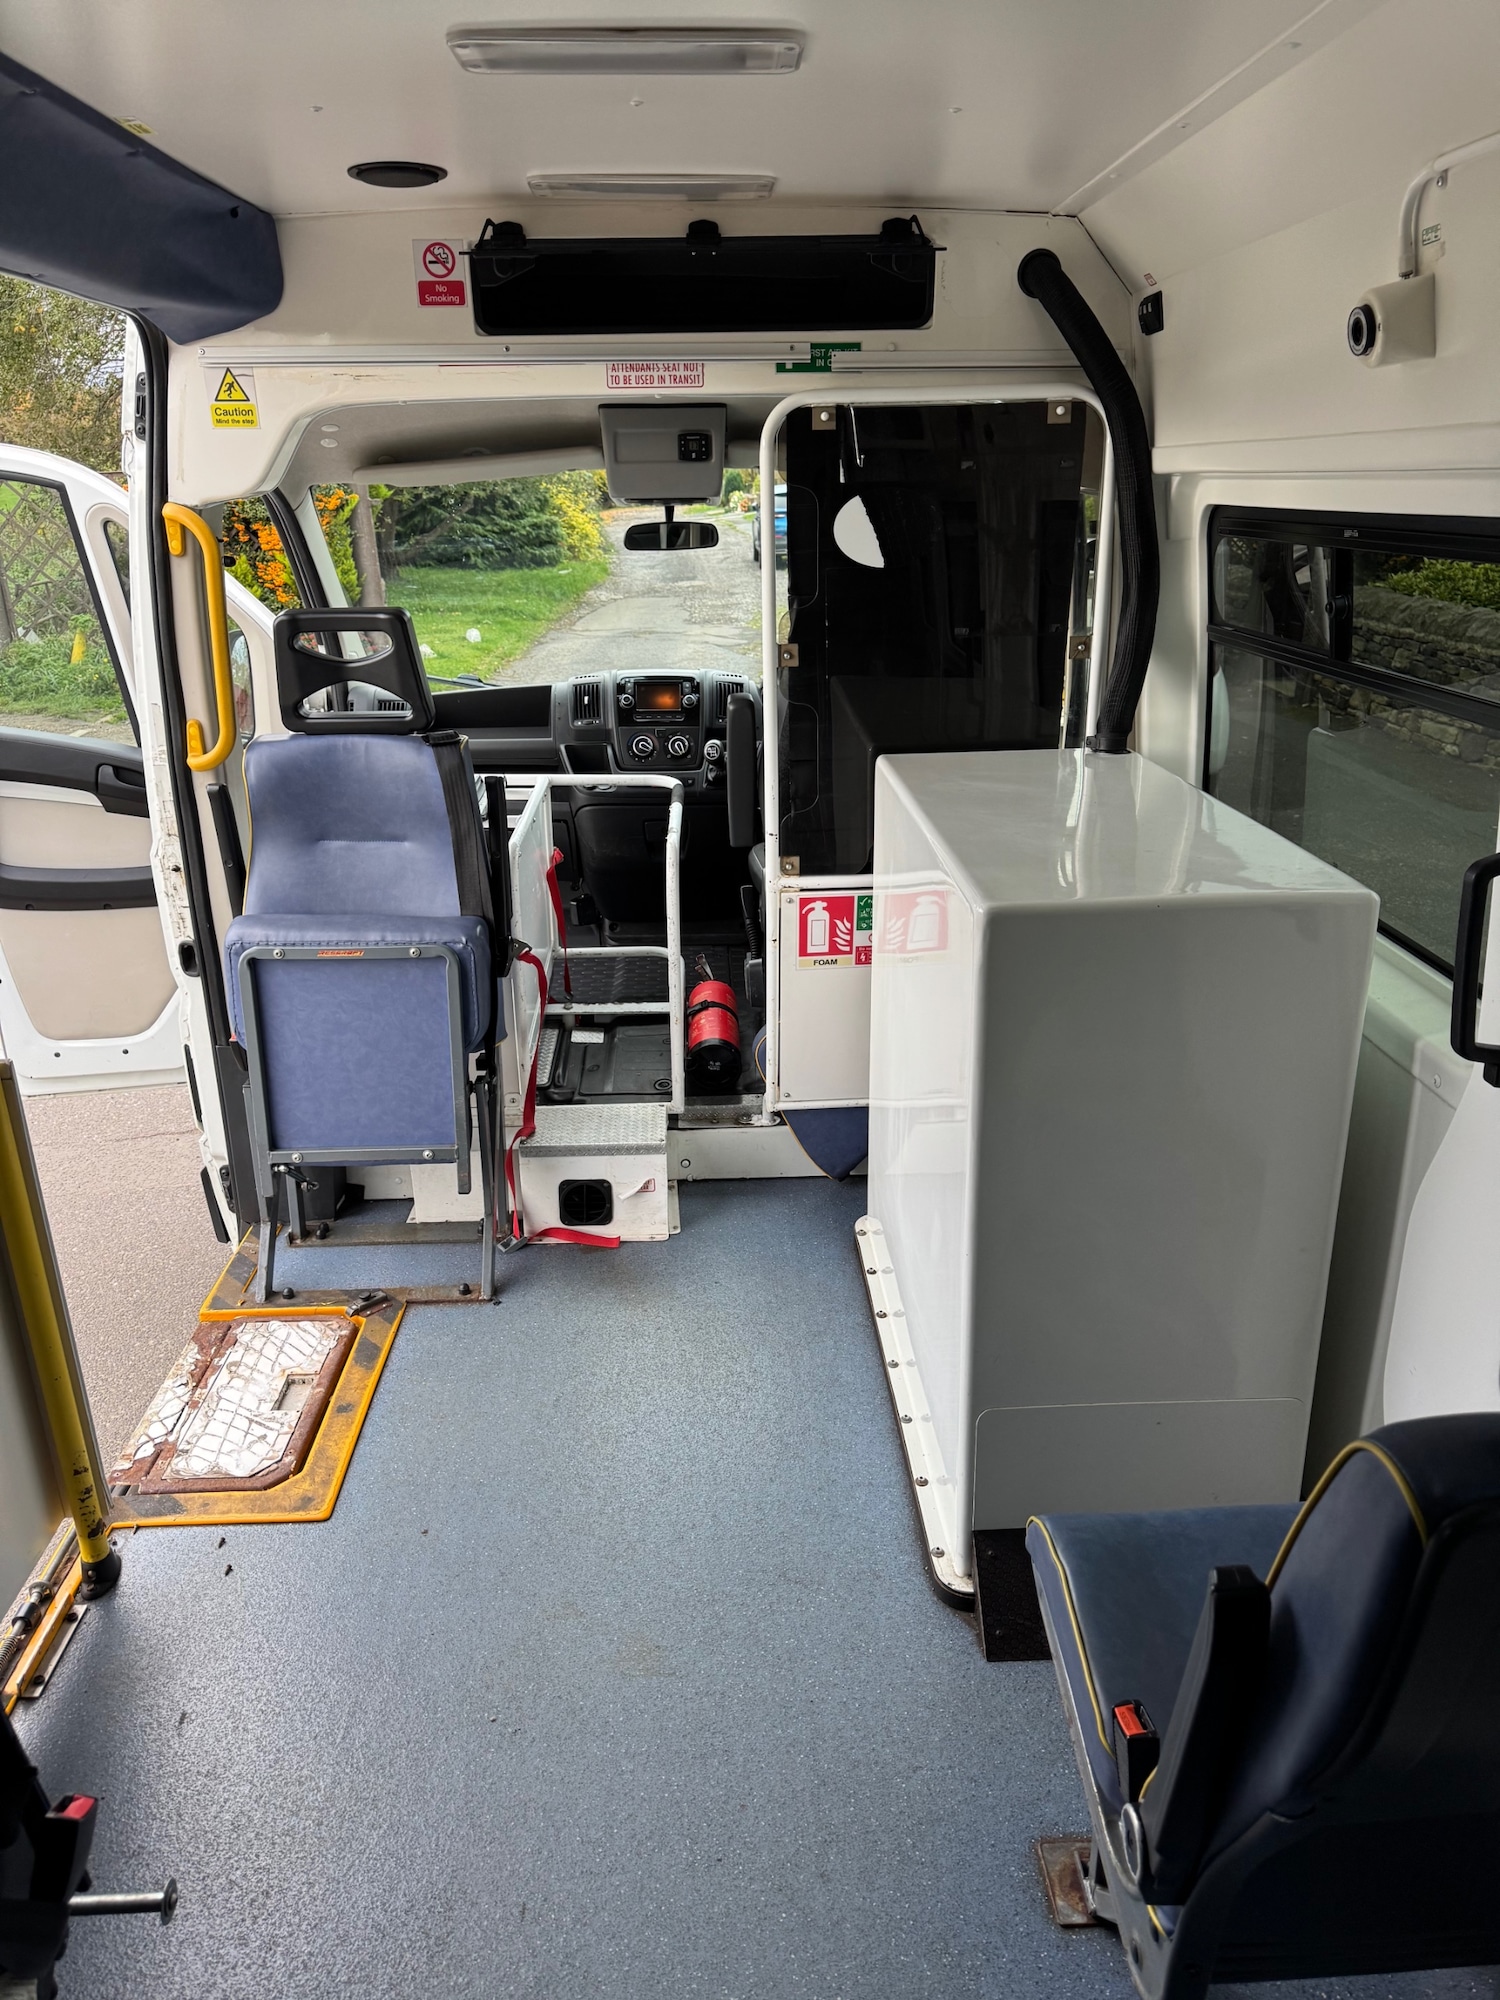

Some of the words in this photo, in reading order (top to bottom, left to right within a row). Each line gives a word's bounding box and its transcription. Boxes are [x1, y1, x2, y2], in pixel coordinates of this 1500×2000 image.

[435, 284, 448, 292] No
[425, 294, 460, 304] Smoking
[611, 362, 660, 372] ATTENDANTS
[662, 362, 680, 372] SEAT
[683, 362, 699, 372] NOT
[610, 374, 620, 384] TO
[623, 374, 632, 384] BE
[635, 374, 654, 384] USED
[658, 374, 666, 384] IN
[668, 374, 700, 384] TRANSIT
[214, 407, 254, 417] Caution
